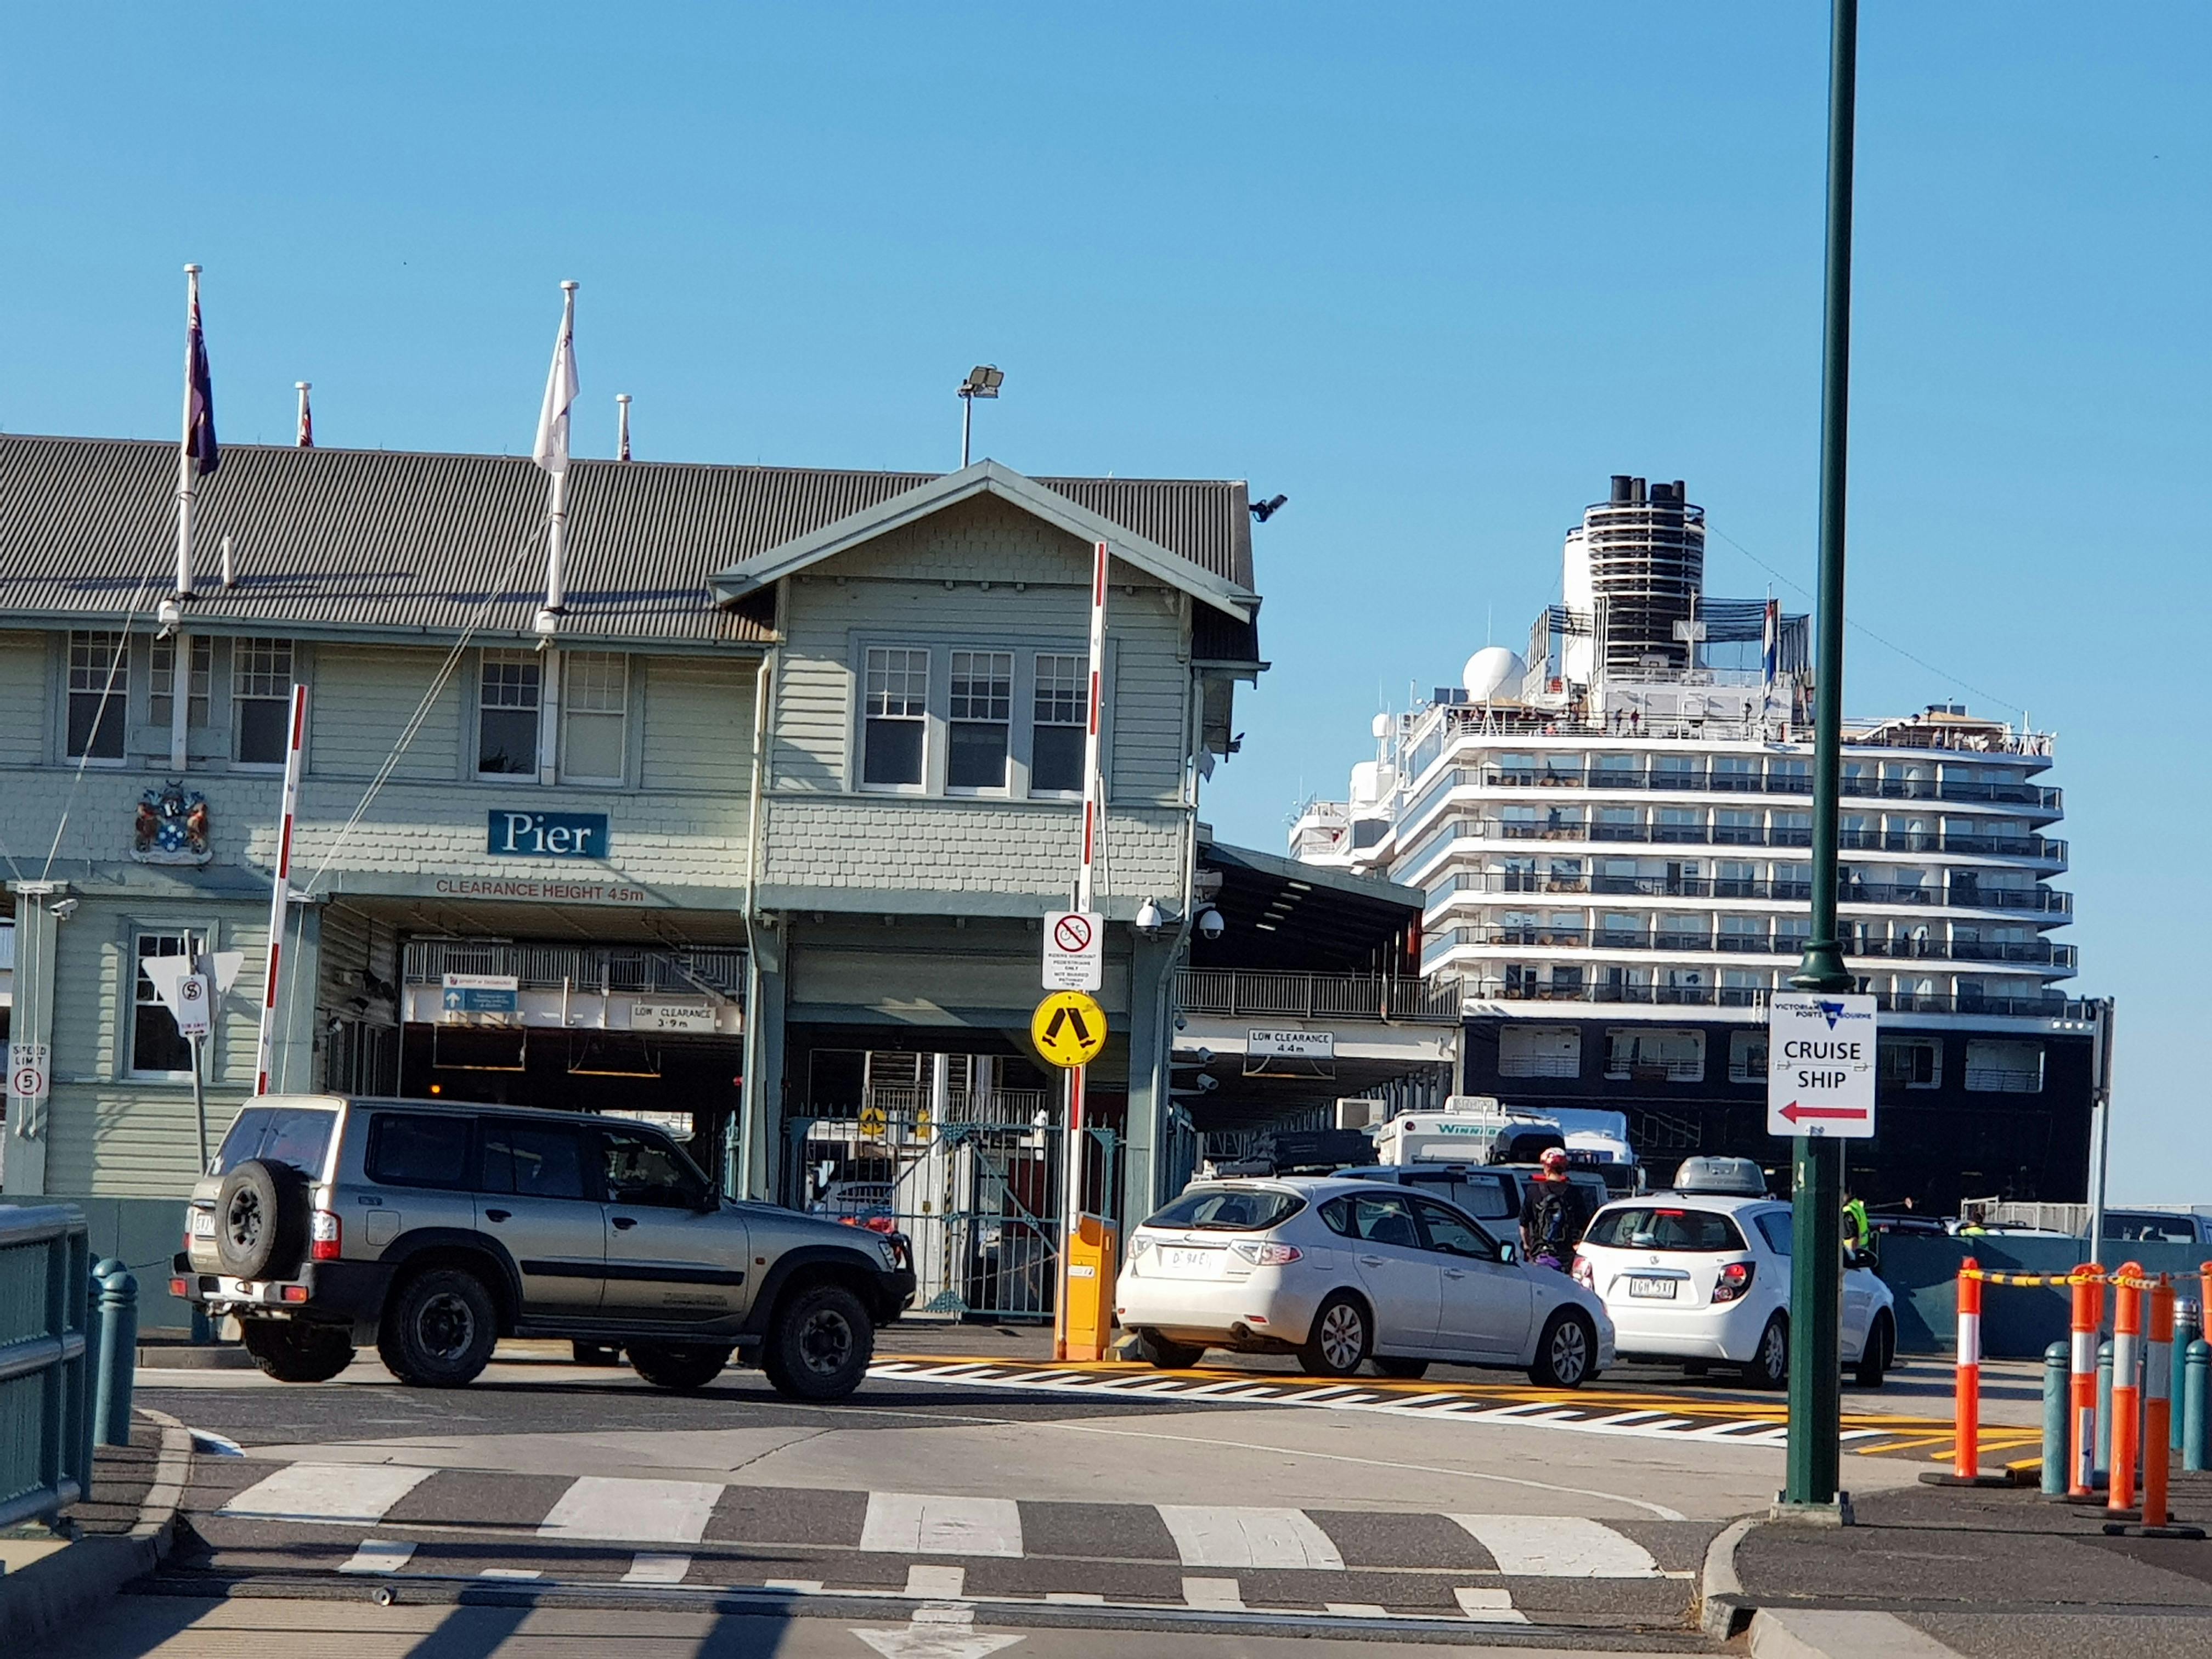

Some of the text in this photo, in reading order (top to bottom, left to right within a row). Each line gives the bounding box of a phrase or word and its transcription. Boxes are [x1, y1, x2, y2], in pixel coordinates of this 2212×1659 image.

[500, 813, 591, 854] Pier
[437, 880, 644, 901] CLEARANCE HEIGHT 4.5m
[635, 1007, 711, 1019] LOW CLEARANCE
[1252, 1032, 1329, 1043] LOW CLEARANCE
[1784, 1041, 1861, 1060] CRUISE
[15, 1057, 42, 1065] LIMT
[24, 1075, 33, 1088] 5
[1798, 1070, 1846, 1088] SHIP
